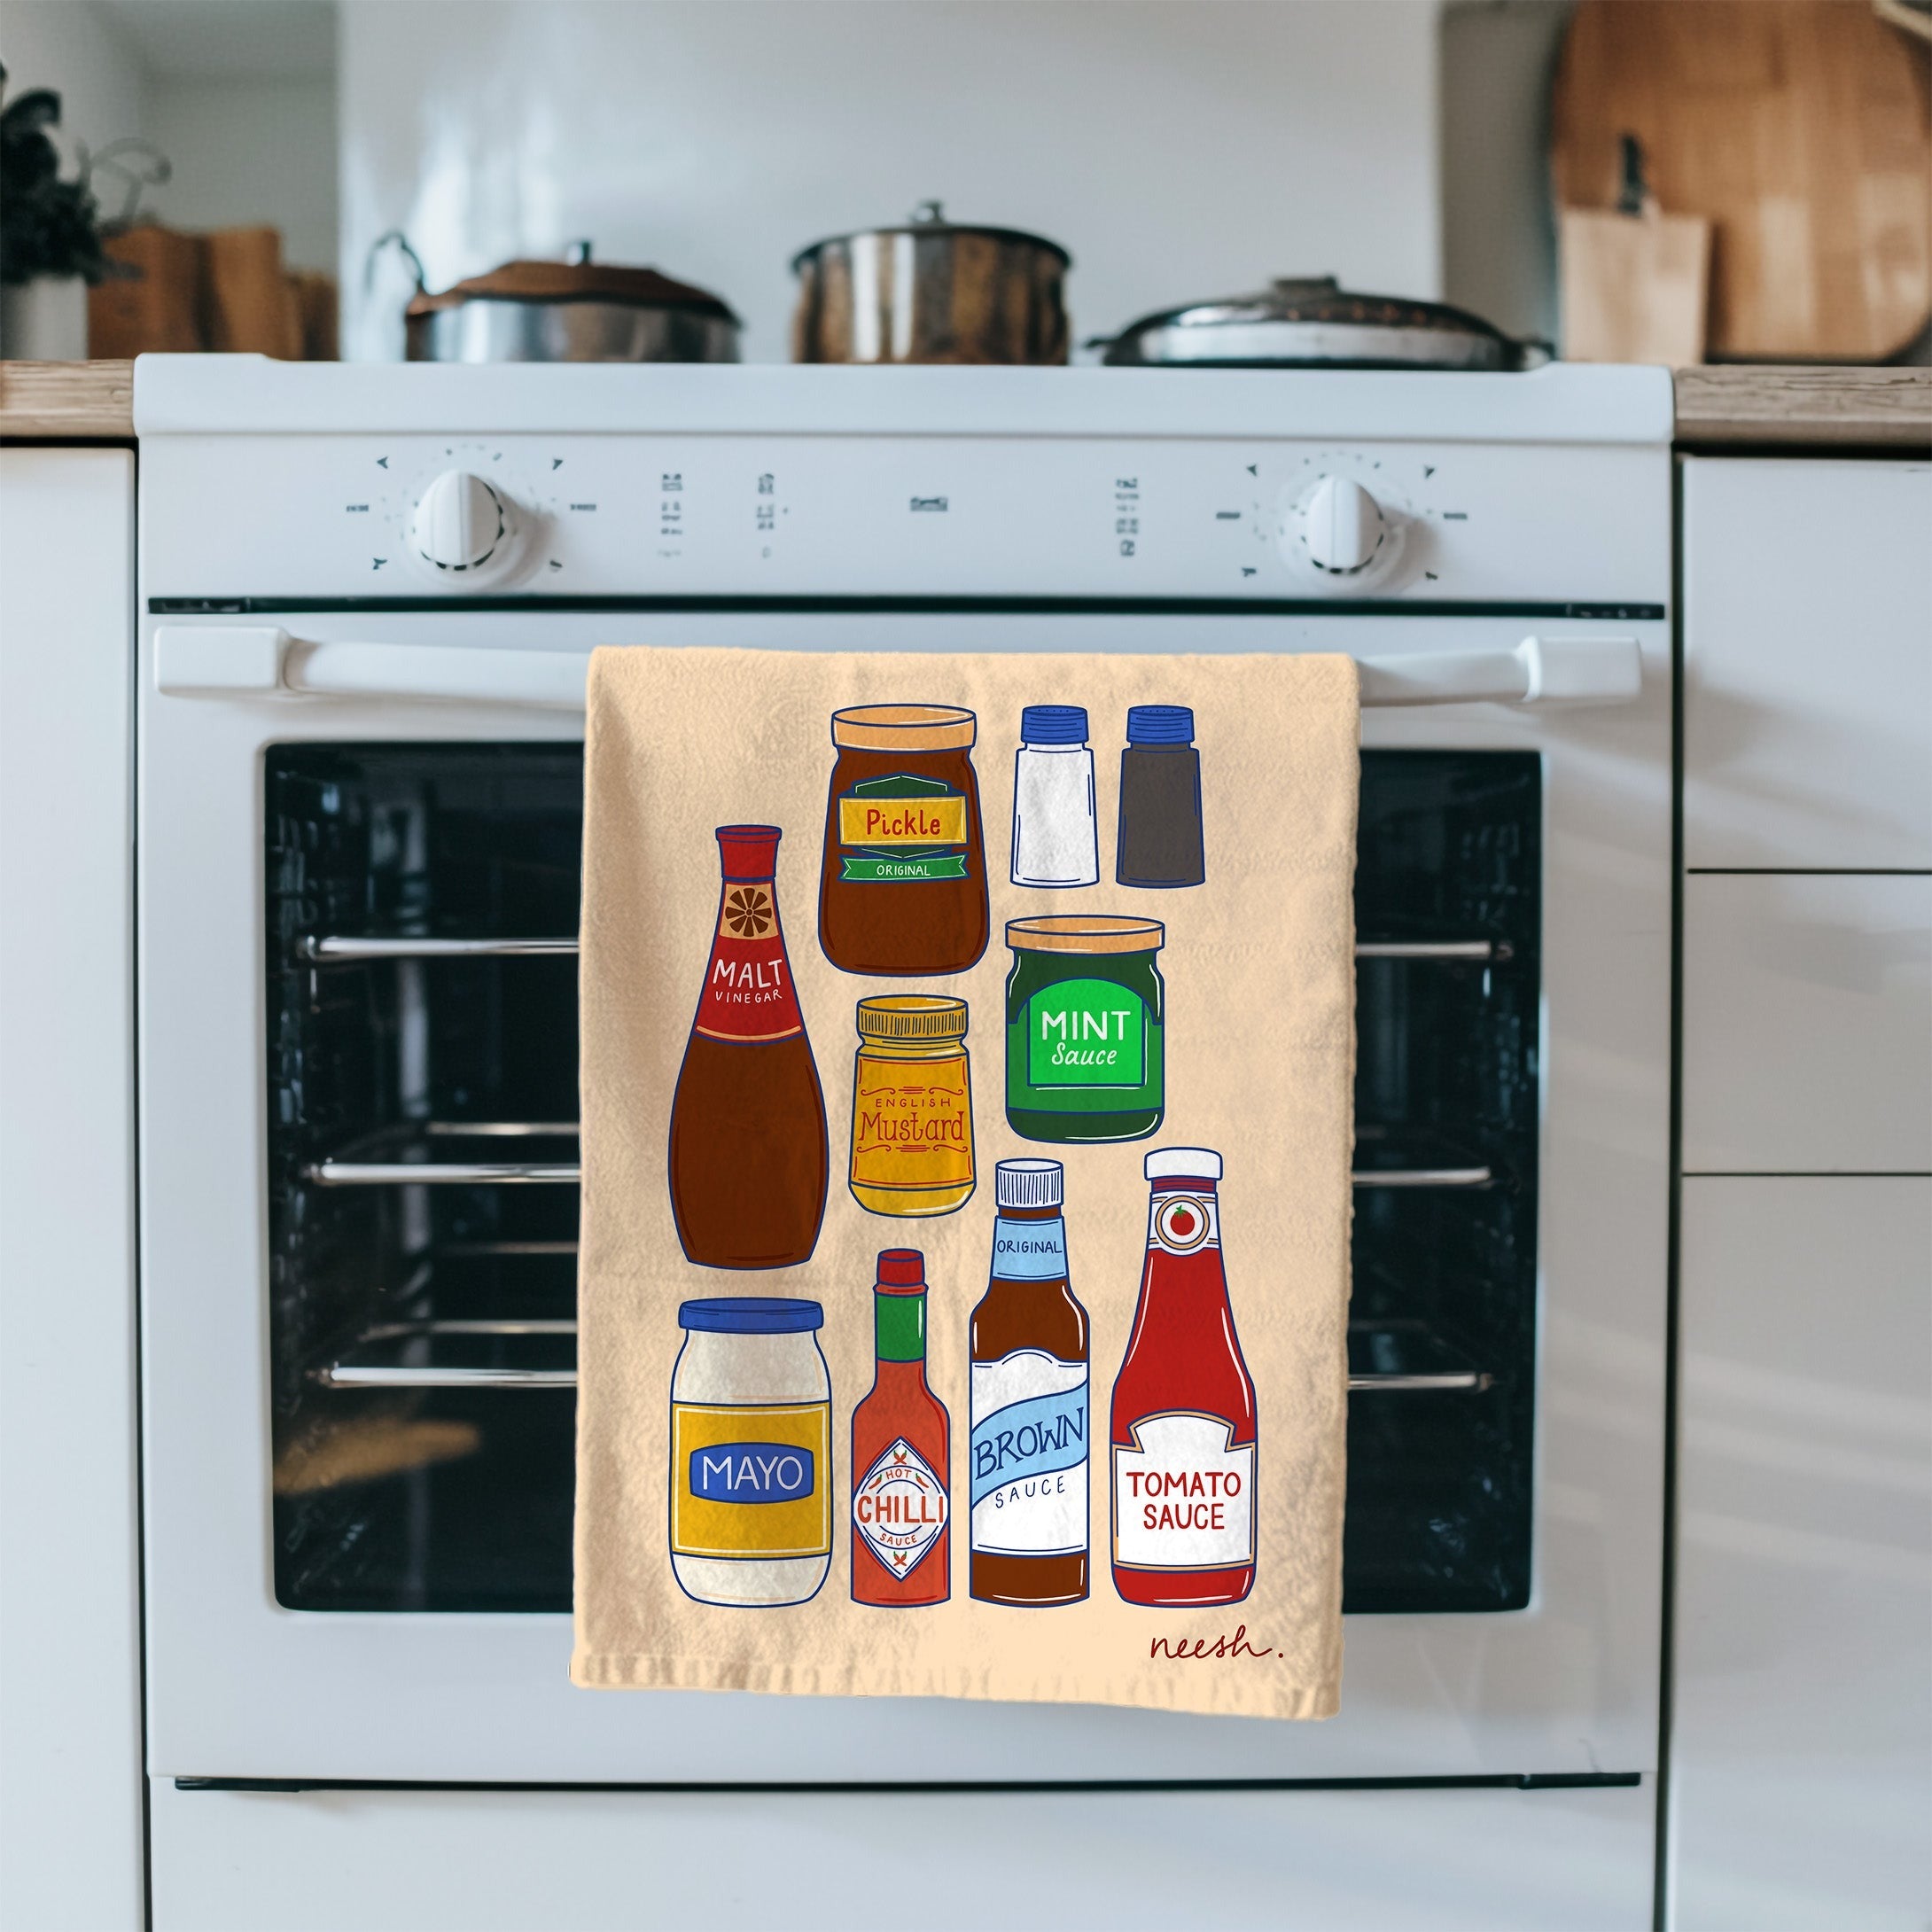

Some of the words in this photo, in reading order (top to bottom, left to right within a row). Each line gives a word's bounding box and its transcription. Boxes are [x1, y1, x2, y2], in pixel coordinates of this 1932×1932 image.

[866, 809, 941, 836] Pickle
[876, 864, 931, 876] ORIGINAL
[713, 958, 783, 989] MALT
[715, 988, 783, 1004] VINEGAR
[1041, 1010, 1132, 1041] MINT
[1051, 1041, 1118, 1065] Sauce
[876, 1097, 952, 1108] ENGLISH
[859, 1110, 965, 1141] Mustard
[996, 1238, 1063, 1255] ORIGINAL
[973, 1406, 1085, 1481] BROWN
[703, 1455, 804, 1491] MAYO
[885, 1468, 913, 1480] HOT
[1126, 1471, 1242, 1498] TOMATO
[995, 1476, 1066, 1509] SAUCE
[857, 1495, 944, 1523] CHILLI
[1142, 1503, 1226, 1531] SAUCE
[879, 1532, 918, 1546] SAUCE
[1150, 1624, 1285, 1659] neesh.
